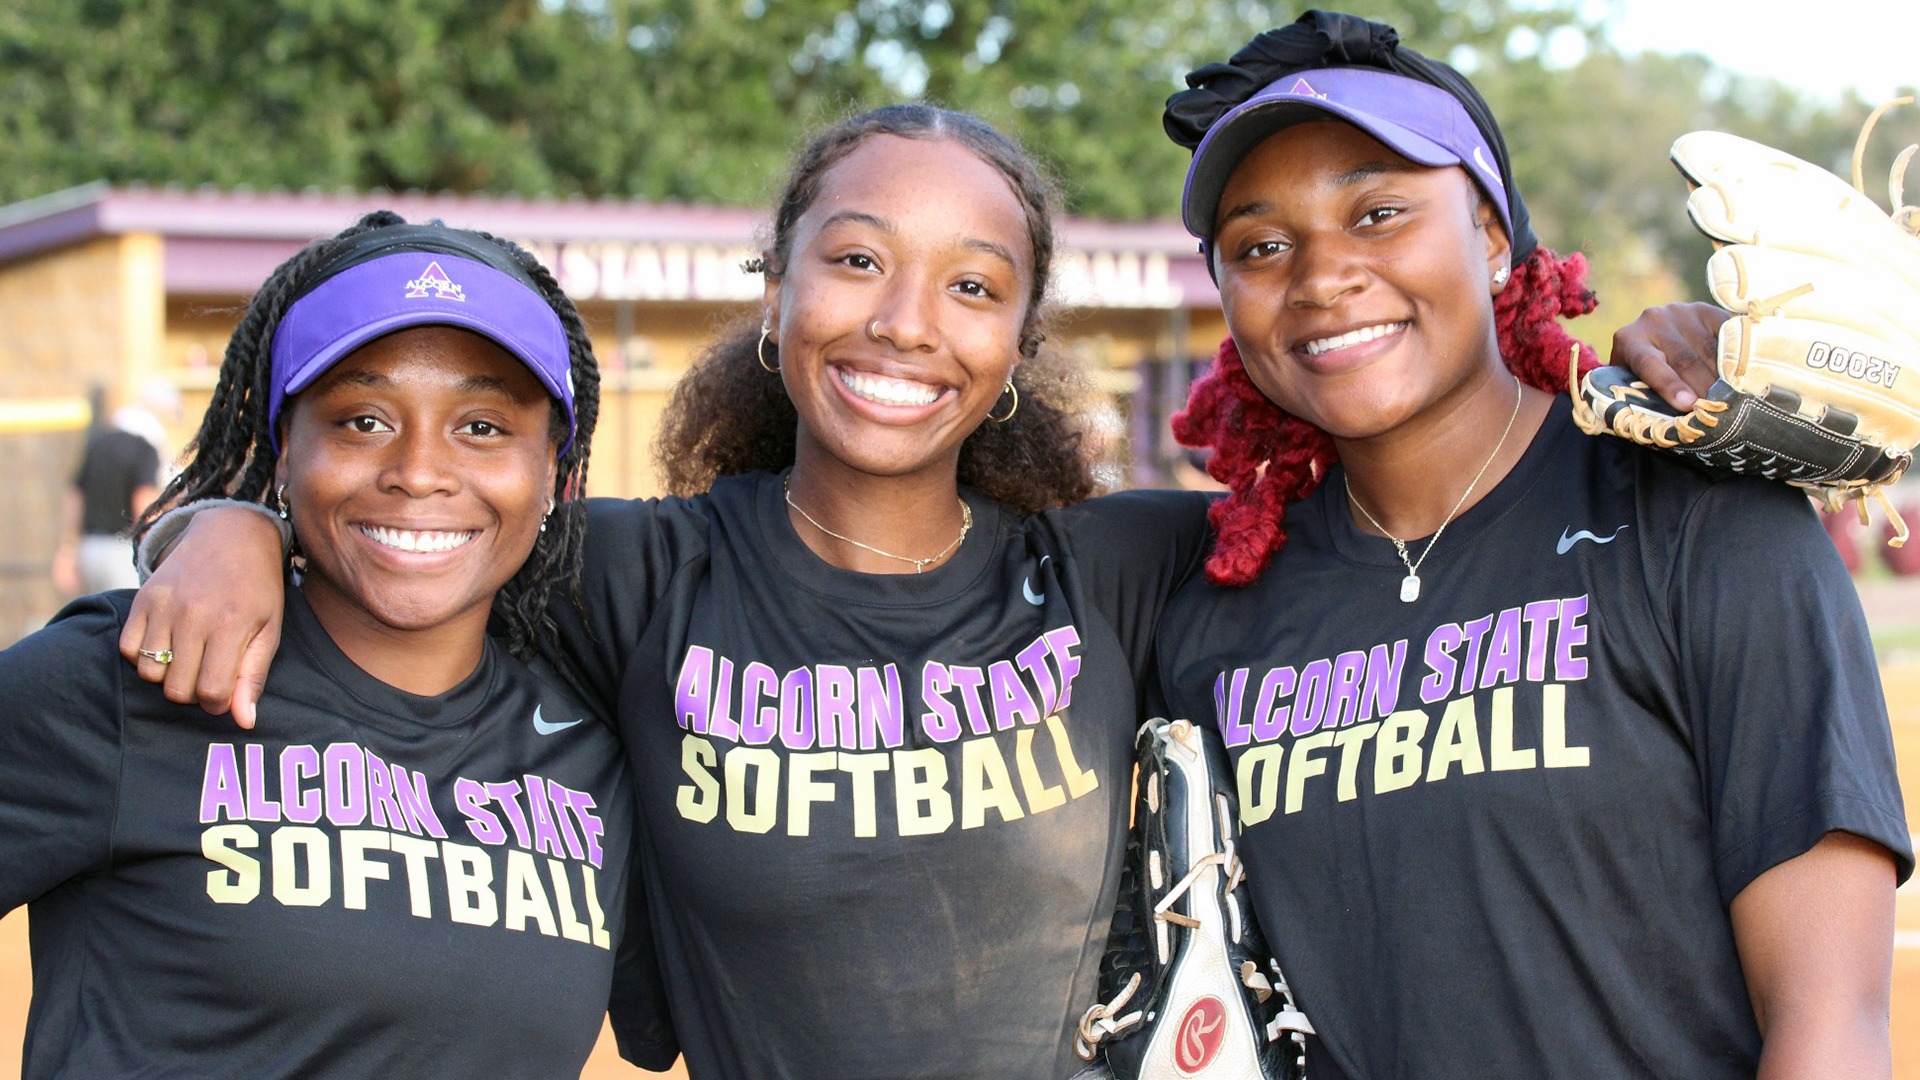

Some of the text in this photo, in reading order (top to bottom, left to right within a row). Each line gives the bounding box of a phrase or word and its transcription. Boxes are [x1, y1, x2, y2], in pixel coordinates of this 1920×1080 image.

[1806, 341, 1901, 389] A2000
[675, 624, 1082, 750] ALCORN STATE
[1419, 593, 1589, 704] STATE
[199, 742, 605, 870] ALCORN STATE
[675, 715, 1100, 838] SOFTBALL
[1236, 683, 1591, 837] OFTBALL
[200, 824, 611, 951] SOFTBALL
